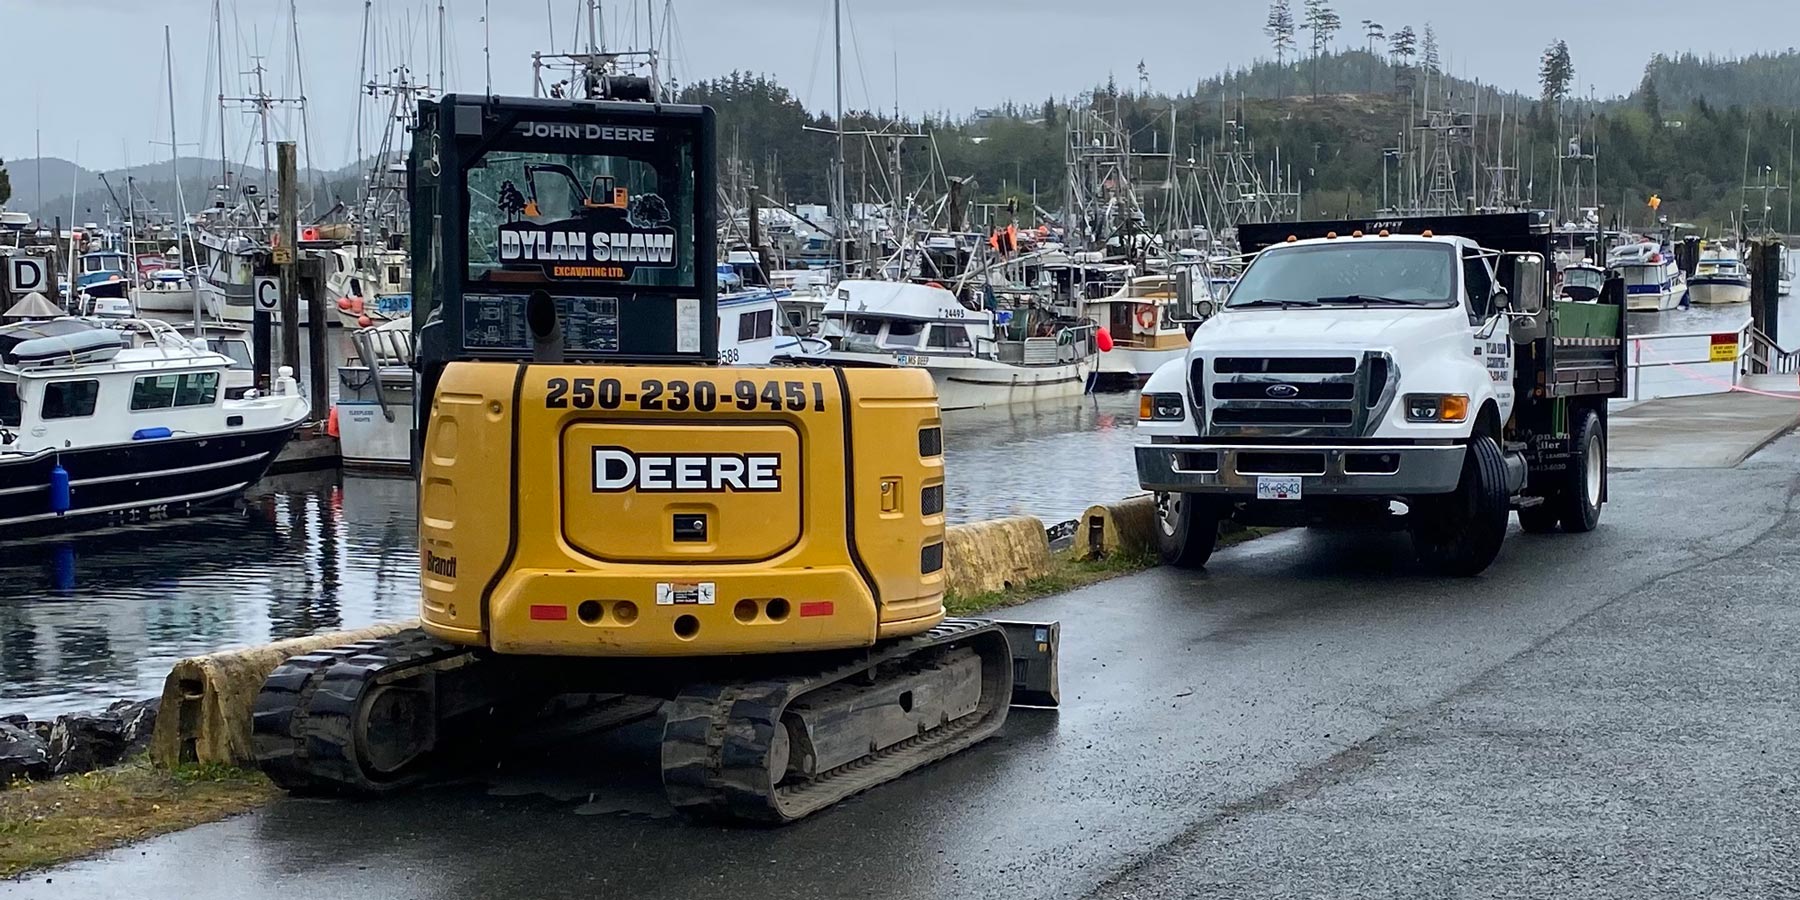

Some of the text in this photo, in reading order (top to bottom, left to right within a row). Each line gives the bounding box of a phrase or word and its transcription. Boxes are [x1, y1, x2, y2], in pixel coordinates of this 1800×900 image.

[522, 121, 655, 141] JOHN DEERE
[501, 230, 674, 262] DYLAN SHAW
[15, 260, 42, 289] D
[554, 266, 625, 277] EXCAVATING LTD.
[258, 280, 277, 308] C
[545, 377, 826, 412] 250-230-9451
[593, 447, 780, 491] DEERE
[427, 550, 457, 578] Brandt
